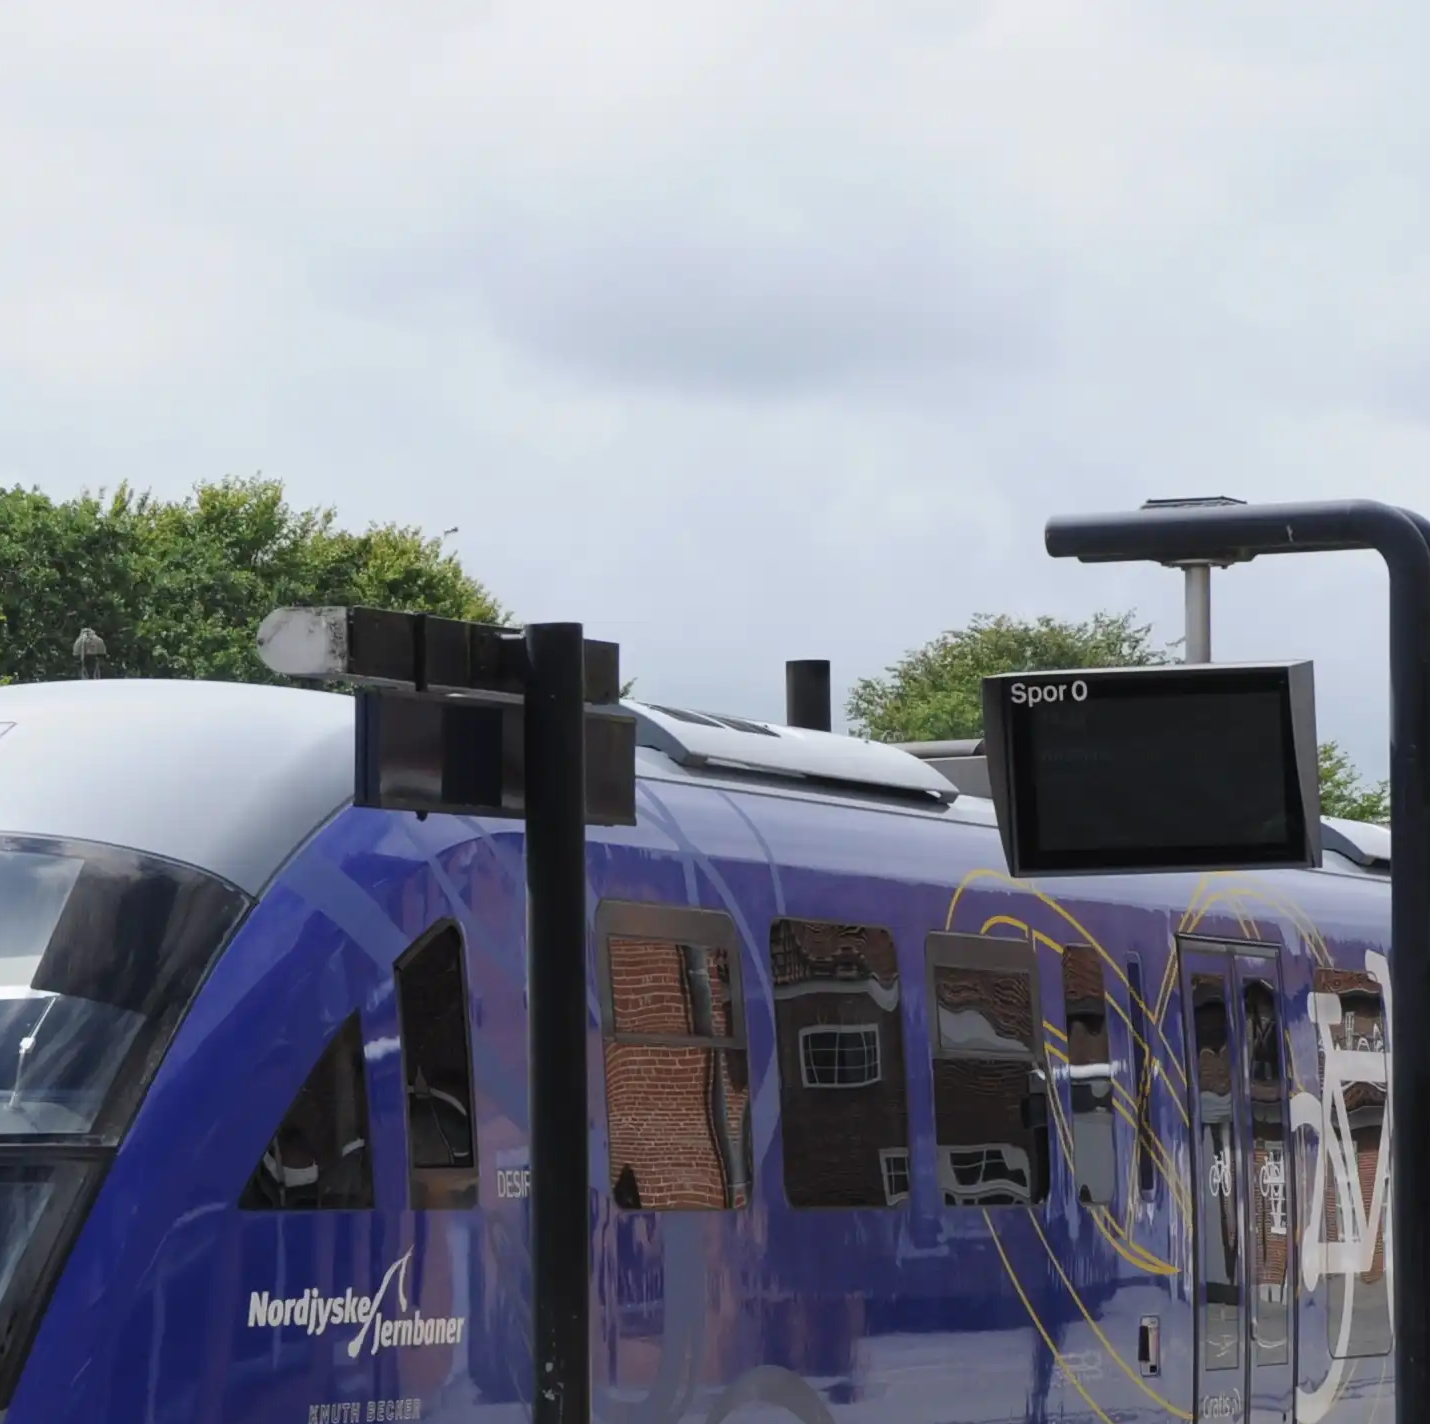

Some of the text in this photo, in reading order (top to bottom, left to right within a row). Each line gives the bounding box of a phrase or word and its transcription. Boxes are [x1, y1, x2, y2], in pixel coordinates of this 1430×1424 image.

[1011, 680, 1088, 708] Spor 0
[497, 1169, 532, 1198] DESIR
[248, 1287, 371, 1335] Nordjyske
[367, 1398, 421, 1422] BECKER
